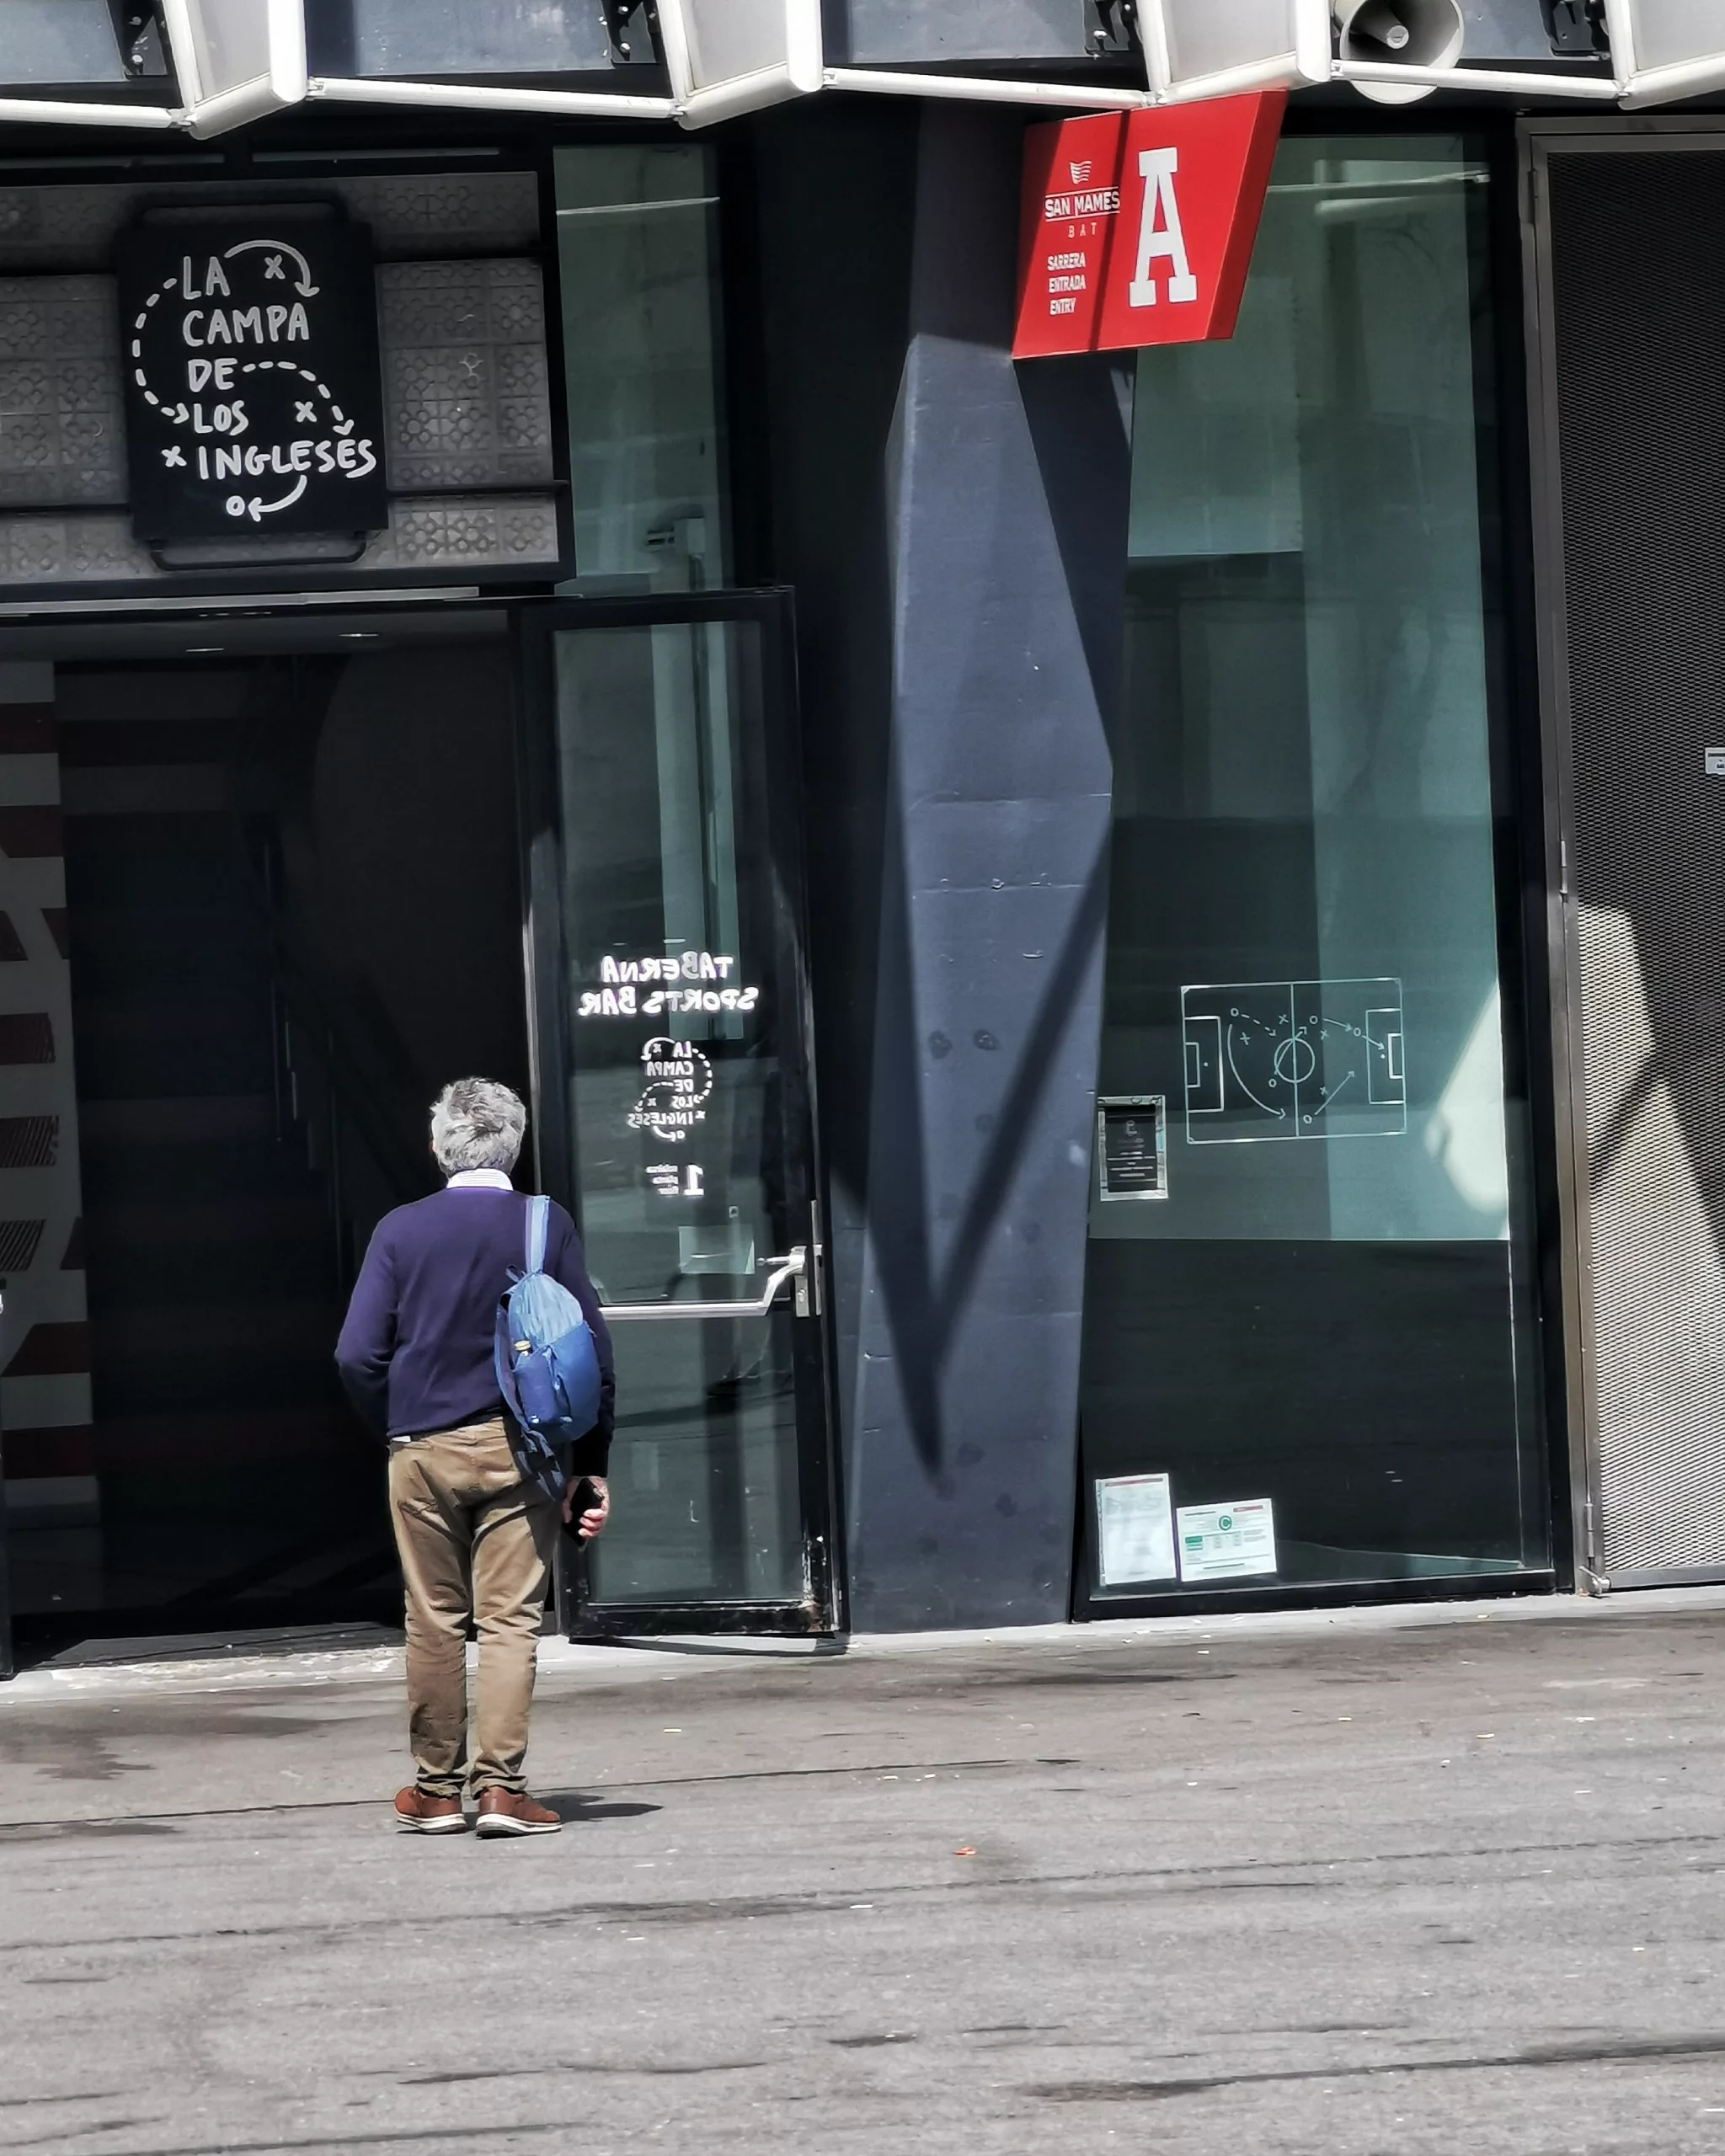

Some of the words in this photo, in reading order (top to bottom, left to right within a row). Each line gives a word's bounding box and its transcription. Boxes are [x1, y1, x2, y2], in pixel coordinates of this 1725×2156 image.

[1045, 195, 1070, 217] SAN
[1074, 190, 1120, 216] MAMES
[1130, 147, 1197, 307] A
[184, 256, 231, 300] LA
[1048, 252, 1086, 271] SARRERA
[1049, 275, 1087, 293] ENTRADA
[1050, 297, 1076, 316] ENTRY
[183, 302, 310, 347] CAMPA
[188, 358, 238, 393] DE
[194, 400, 249, 436] LOS
[199, 438, 377, 480] INGLESES
